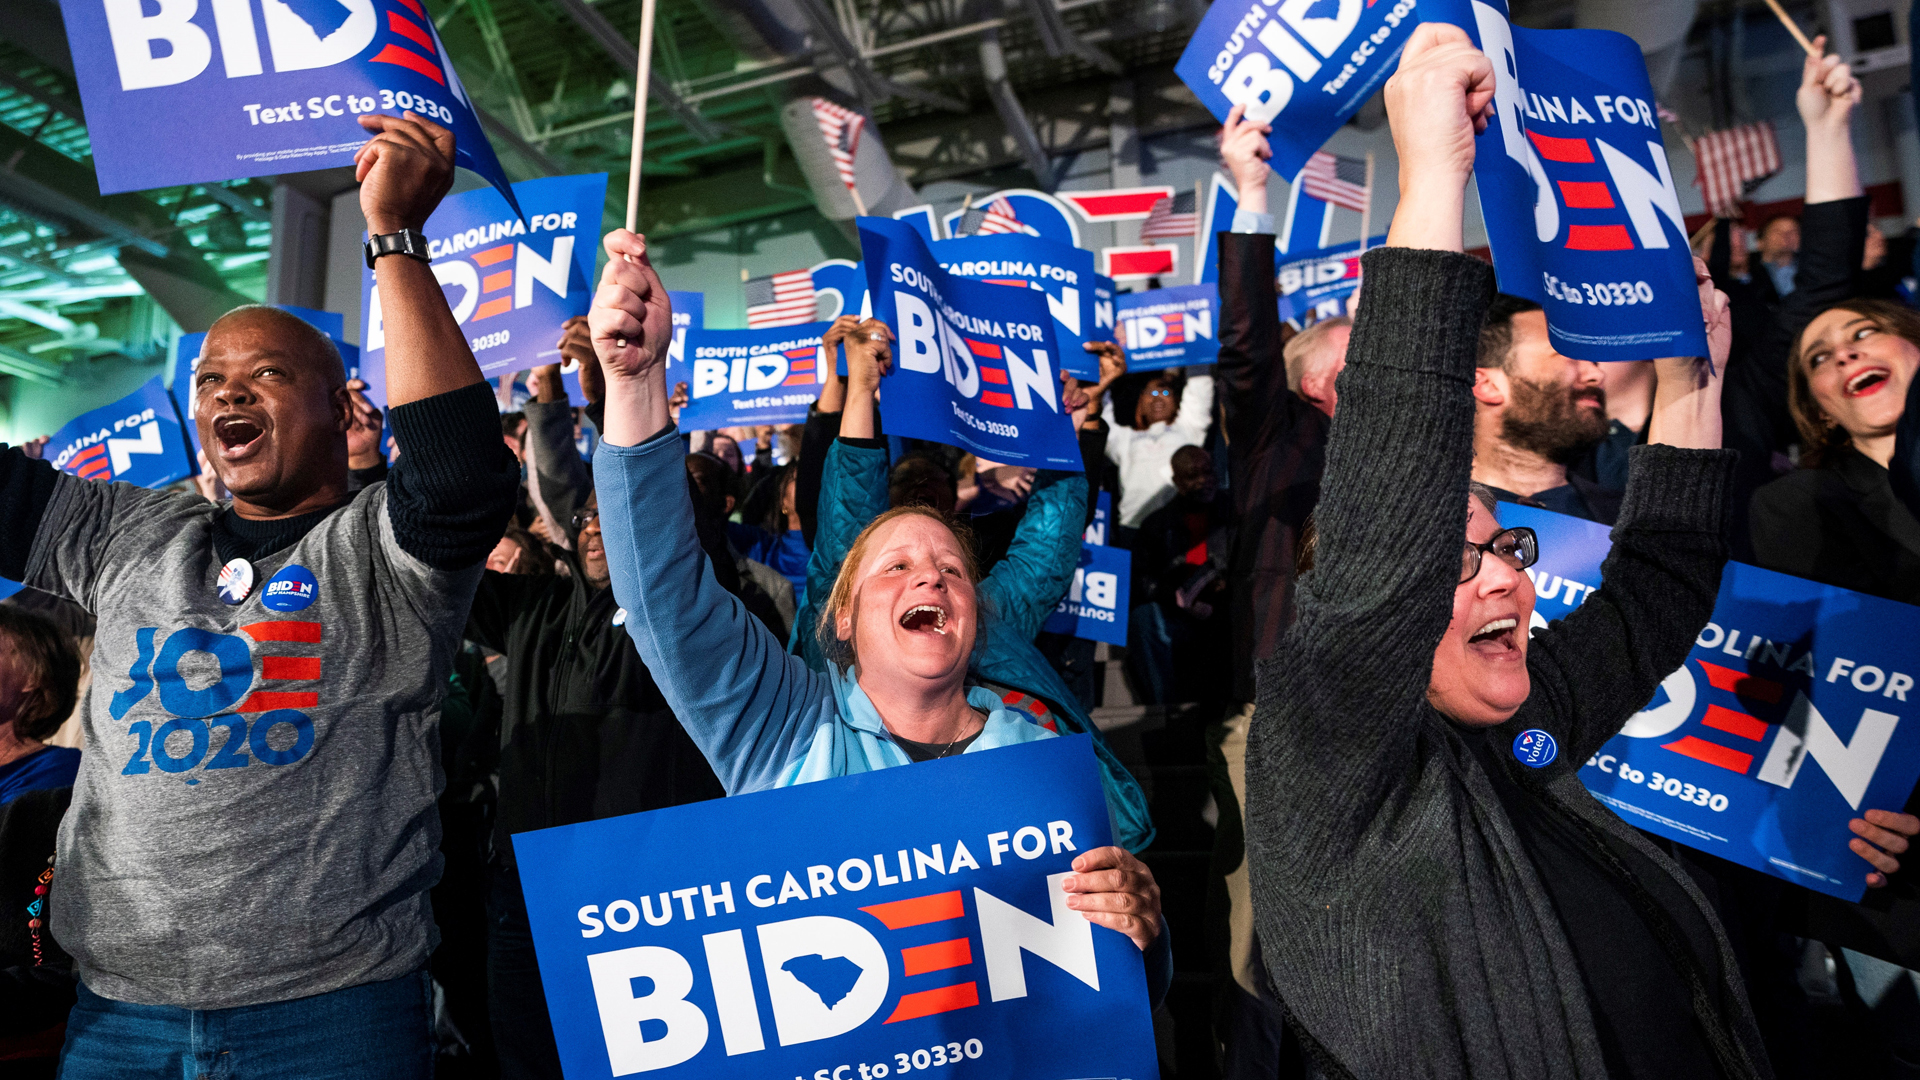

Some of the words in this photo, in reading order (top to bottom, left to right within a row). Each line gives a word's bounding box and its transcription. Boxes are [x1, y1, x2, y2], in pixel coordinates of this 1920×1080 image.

[1208, 5, 1268, 86] SOUTH
[1322, 63, 1358, 95] Text
[1350, 41, 1376, 67] SC
[1370, 26, 1391, 45] to
[1384, 0, 1416, 28] 303
[243, 102, 304, 126] Text
[306, 95, 344, 119] SC
[347, 94, 376, 114] to
[379, 89, 453, 124] 30330
[1594, 95, 1657, 130] FOR
[429, 219, 527, 259] CAROLINA
[530, 212, 578, 233] FOR
[1040, 264, 1078, 285] FOR
[1562, 280, 1583, 305] to
[1581, 281, 1654, 306] 30330
[471, 329, 510, 352] 30330
[695, 346, 747, 358] SOUTH
[749, 336, 823, 356] CAROLINA
[1006, 321, 1044, 343] FOR
[1125, 309, 1212, 350] IDEN
[894, 290, 1058, 414] BIDEN
[114, 408, 155, 432] FOR
[732, 399, 754, 410] Text
[755, 397, 769, 408] SC
[770, 397, 782, 406] to
[782, 394, 816, 406] 30330
[975, 418, 987, 431] to
[986, 420, 1019, 438] 30330
[268, 580, 313, 594] BIDEN
[1069, 603, 1115, 622] SOUTH
[109, 620, 322, 720] JOE
[1825, 656, 1915, 702] FOR
[121, 709, 315, 775] 2020
[1526, 733, 1547, 762] Voted
[1619, 762, 1645, 784] to
[1648, 771, 1729, 812] 30330
[578, 881, 736, 939] SOUTH
[745, 839, 980, 908] CAROLINA
[987, 819, 1077, 866] FOR
[586, 871, 1100, 1078] BIDEN
[858, 1062, 889, 1080] to
[894, 1038, 984, 1074] 30330
